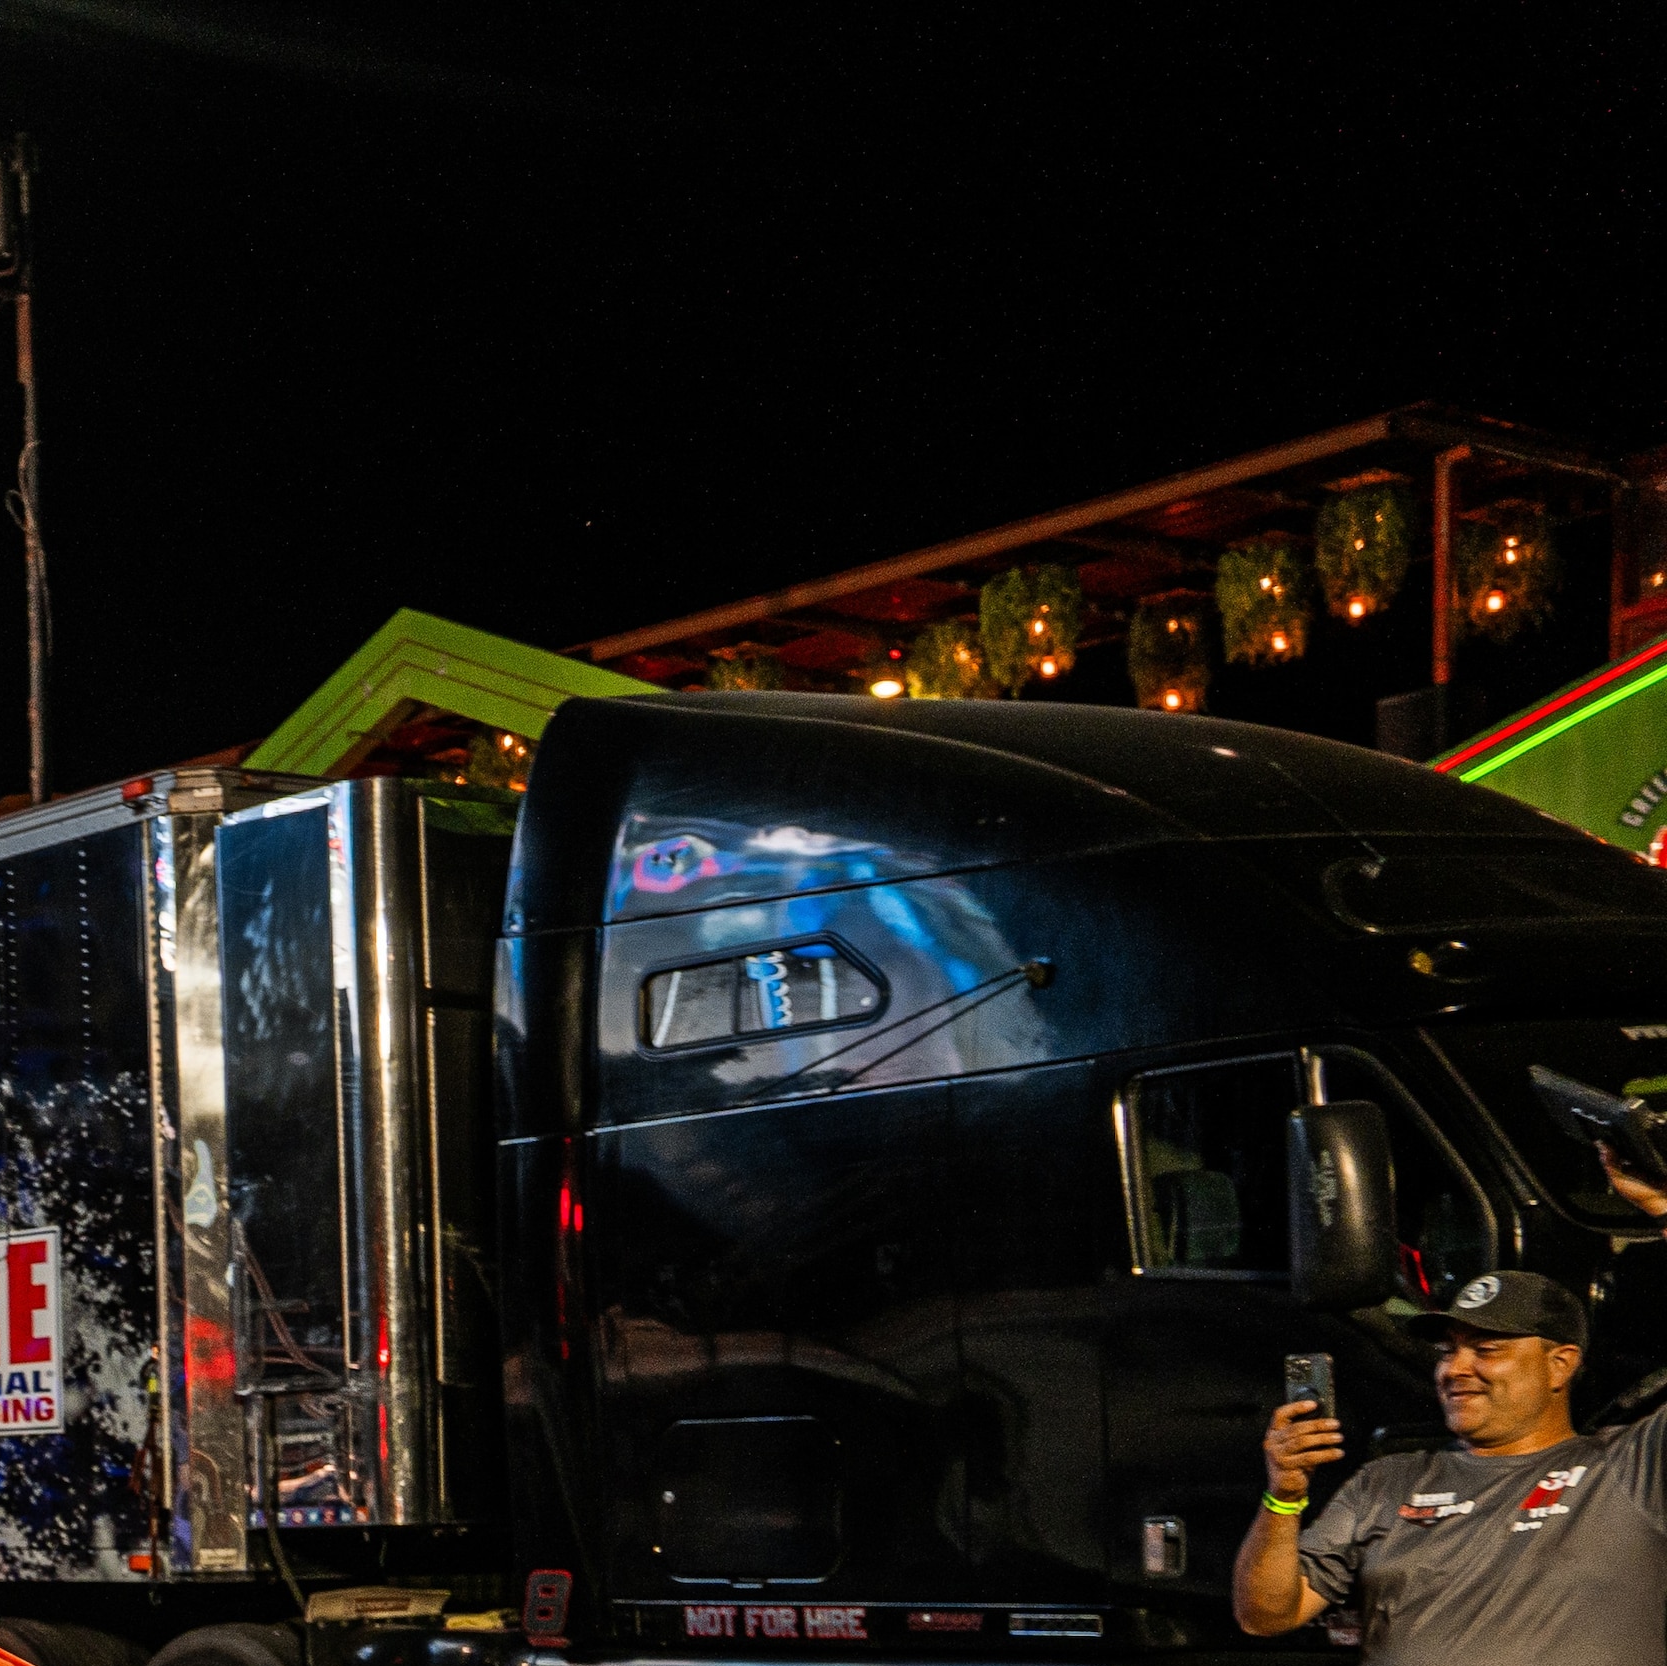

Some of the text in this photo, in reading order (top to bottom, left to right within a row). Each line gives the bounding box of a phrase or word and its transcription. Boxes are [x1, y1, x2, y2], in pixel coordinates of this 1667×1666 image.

[684, 1606, 737, 1638] NOT
[744, 1606, 800, 1638] FOR
[803, 1606, 867, 1639] HIRE
